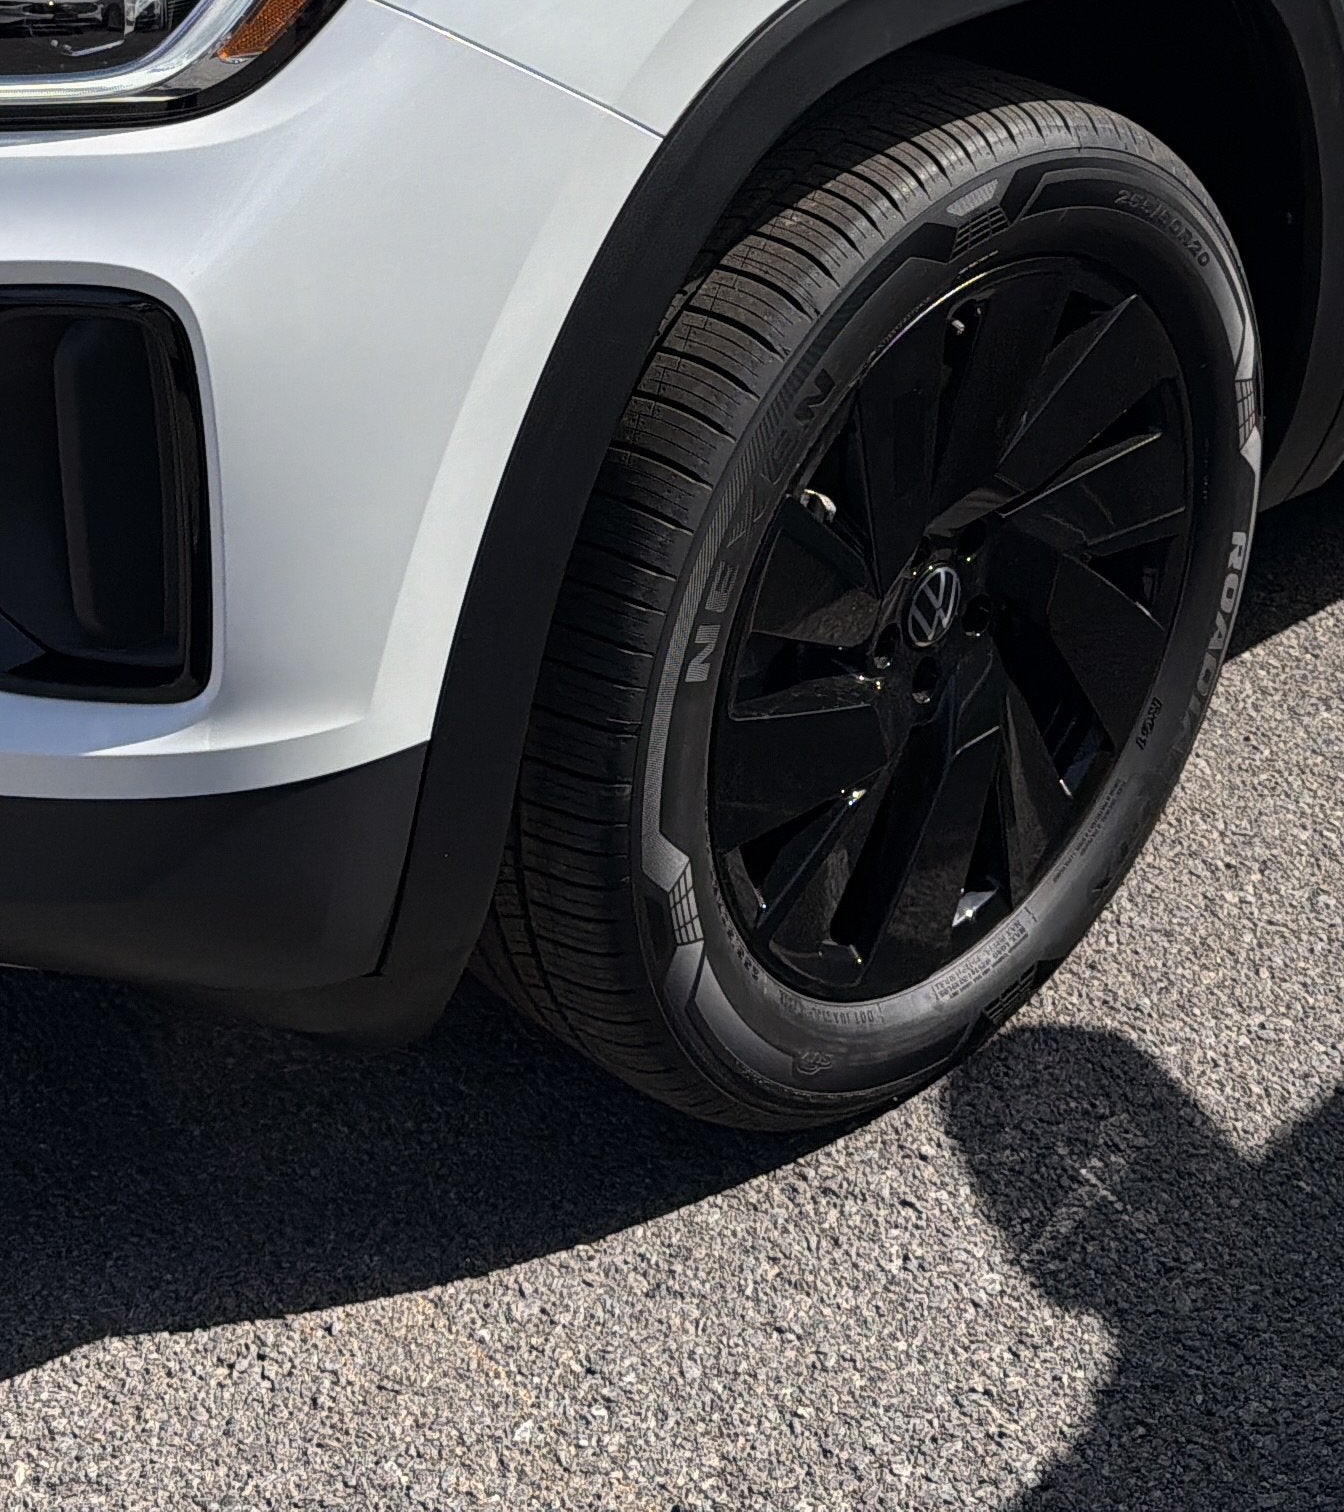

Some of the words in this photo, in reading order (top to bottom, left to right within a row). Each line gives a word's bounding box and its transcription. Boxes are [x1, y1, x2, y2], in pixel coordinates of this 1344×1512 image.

[1113, 189, 1211, 267] 255/50R20
[684, 367, 836, 684] NEXEN
[907, 566, 959, 647] VW
[1170, 530, 1247, 758] ROADIA
